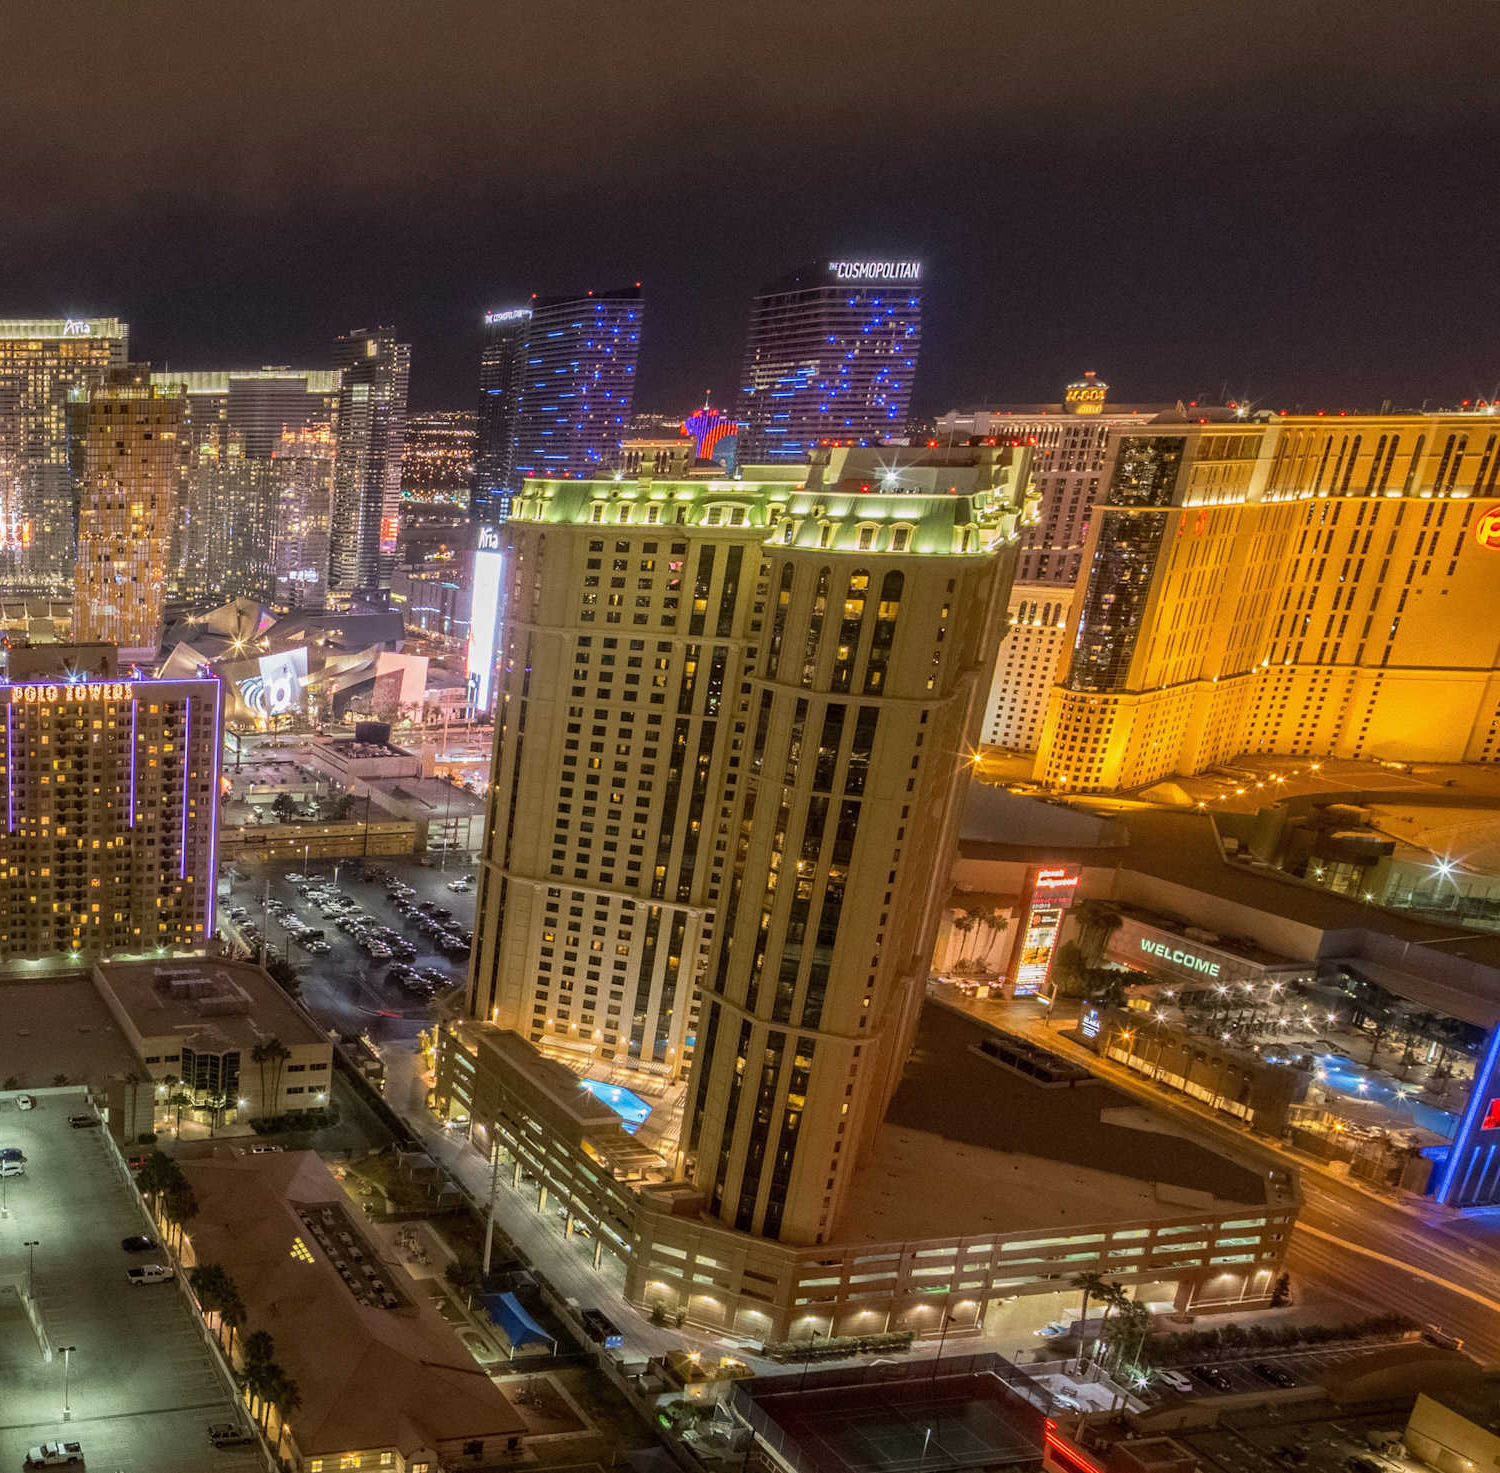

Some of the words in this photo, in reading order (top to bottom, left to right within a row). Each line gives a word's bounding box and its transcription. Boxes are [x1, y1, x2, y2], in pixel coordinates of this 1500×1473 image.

[828, 262, 838, 271] THE
[838, 261, 921, 279] COSMOPOLITAN
[63, 318, 90, 336] Aria
[478, 527, 499, 549] Aria
[12, 685, 58, 704] POLO
[65, 682, 132, 701] TOWERS
[1141, 937, 1220, 977] WELCOME
